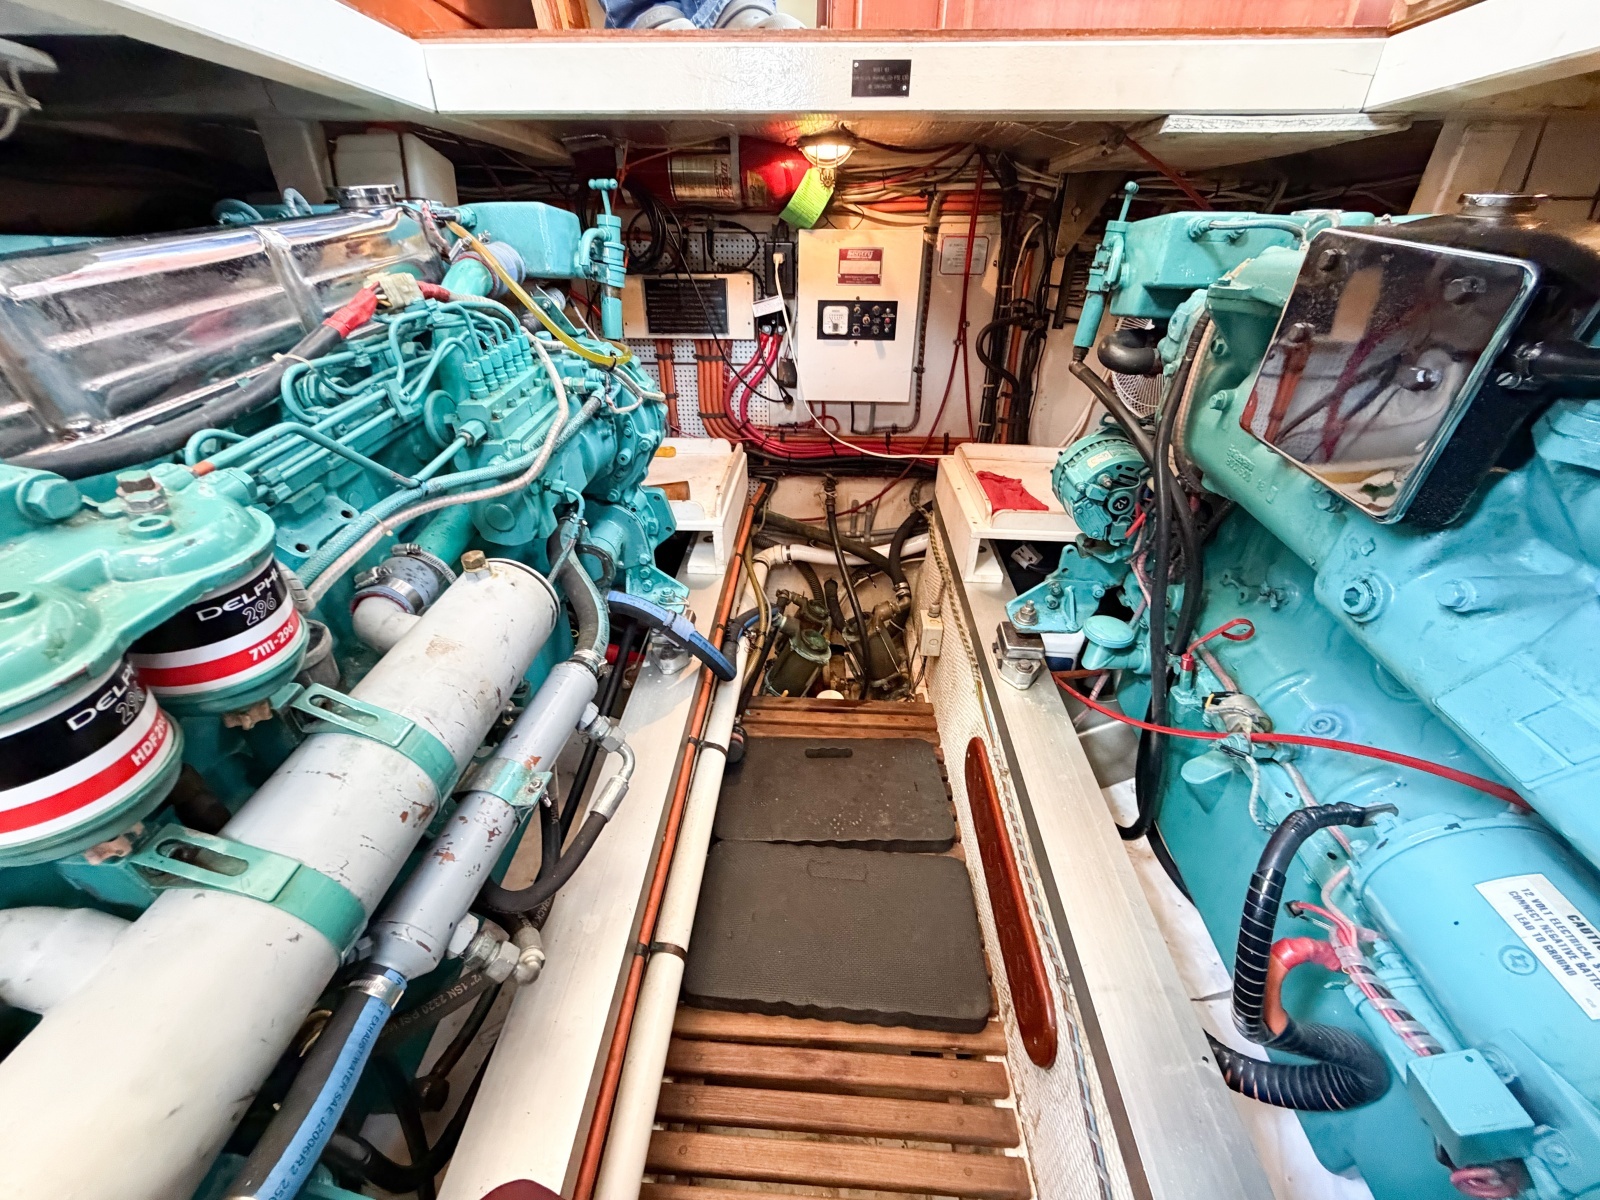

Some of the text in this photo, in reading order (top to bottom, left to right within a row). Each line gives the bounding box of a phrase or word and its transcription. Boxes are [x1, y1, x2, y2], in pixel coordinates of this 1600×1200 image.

[242, 591, 276, 626] 296
[249, 621, 294, 661] 7111-296
[1508, 890, 1545, 922] CONNECT
[1540, 924, 1580, 961] NEGATIVE
[1513, 912, 1578, 977] LEAD TO GROUND
[1520, 887, 1535, 898] 12
[1531, 898, 1554, 916] VOLT
[1549, 917, 1596, 962] ELECTRICAL
[325, 1091, 343, 1117] SAE
